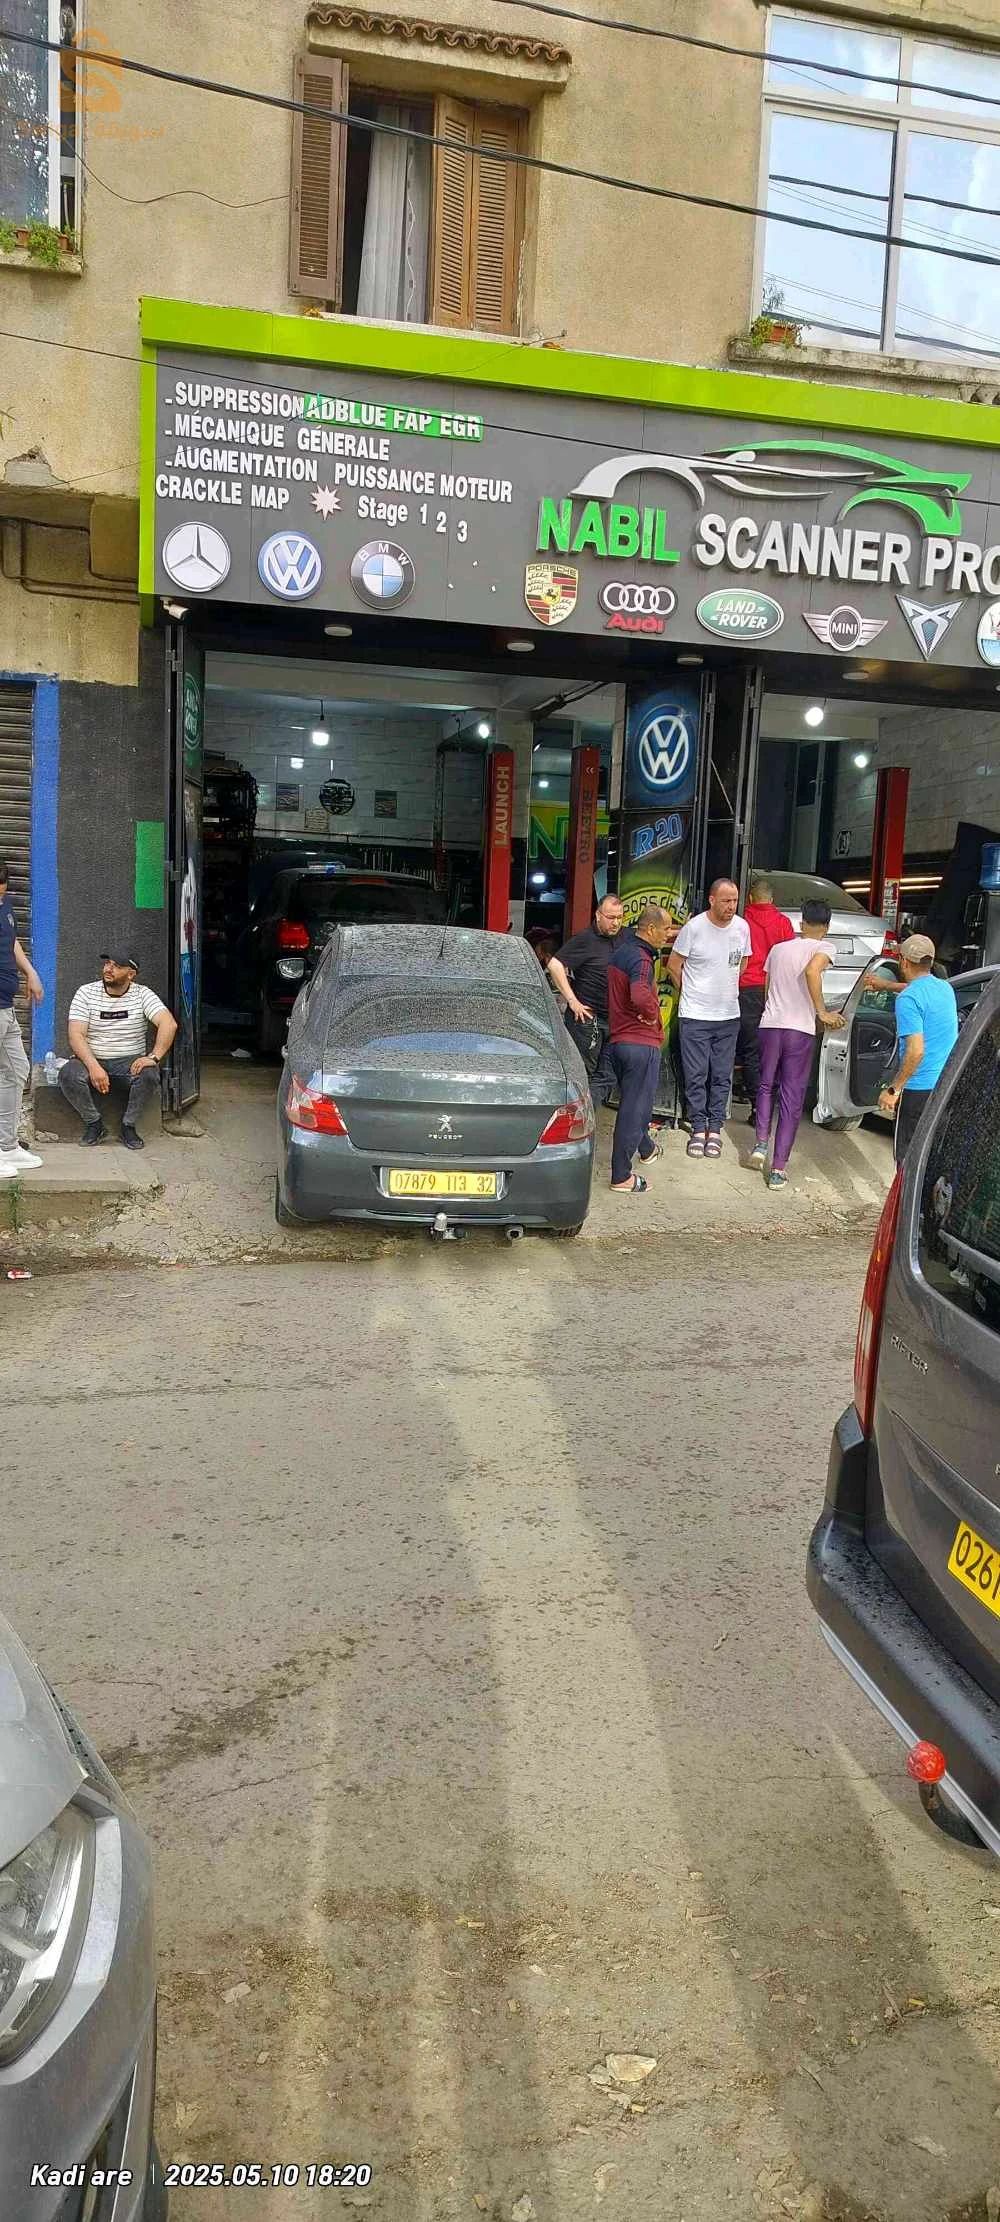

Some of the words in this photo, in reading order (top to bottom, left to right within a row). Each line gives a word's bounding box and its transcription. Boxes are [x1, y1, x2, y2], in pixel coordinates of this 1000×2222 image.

[305, 394, 387, 427] ADBLUE
[393, 408, 433, 432] FAP
[440, 412, 482, 438] EGR
[297, 425, 390, 461] GÉNERALE
[155, 474, 242, 505] CRACKLE
[251, 484, 290, 510] MAP
[334, 462, 435, 495] PUISSANCE
[440, 473, 513, 503] MOTEUR
[357, 494, 409, 527] Stage
[420, 503, 428, 525] 1
[436, 511, 447, 533] 2
[457, 520, 468, 542] 3
[536, 496, 681, 564] NABIL
[694, 512, 911, 586] SCANNER
[526, 563, 578, 577] PORSCHE
[715, 599, 757, 614] LAND
[718, 613, 769, 630] ROVER
[831, 621, 858, 636] MINI
[494, 766, 510, 846] LAUNCH
[395, 1172, 436, 1191] 07879
[446, 1174, 467, 1192] 113
[476, 1176, 493, 1193] 32
[890, 1334, 929, 1376] RIFTER
